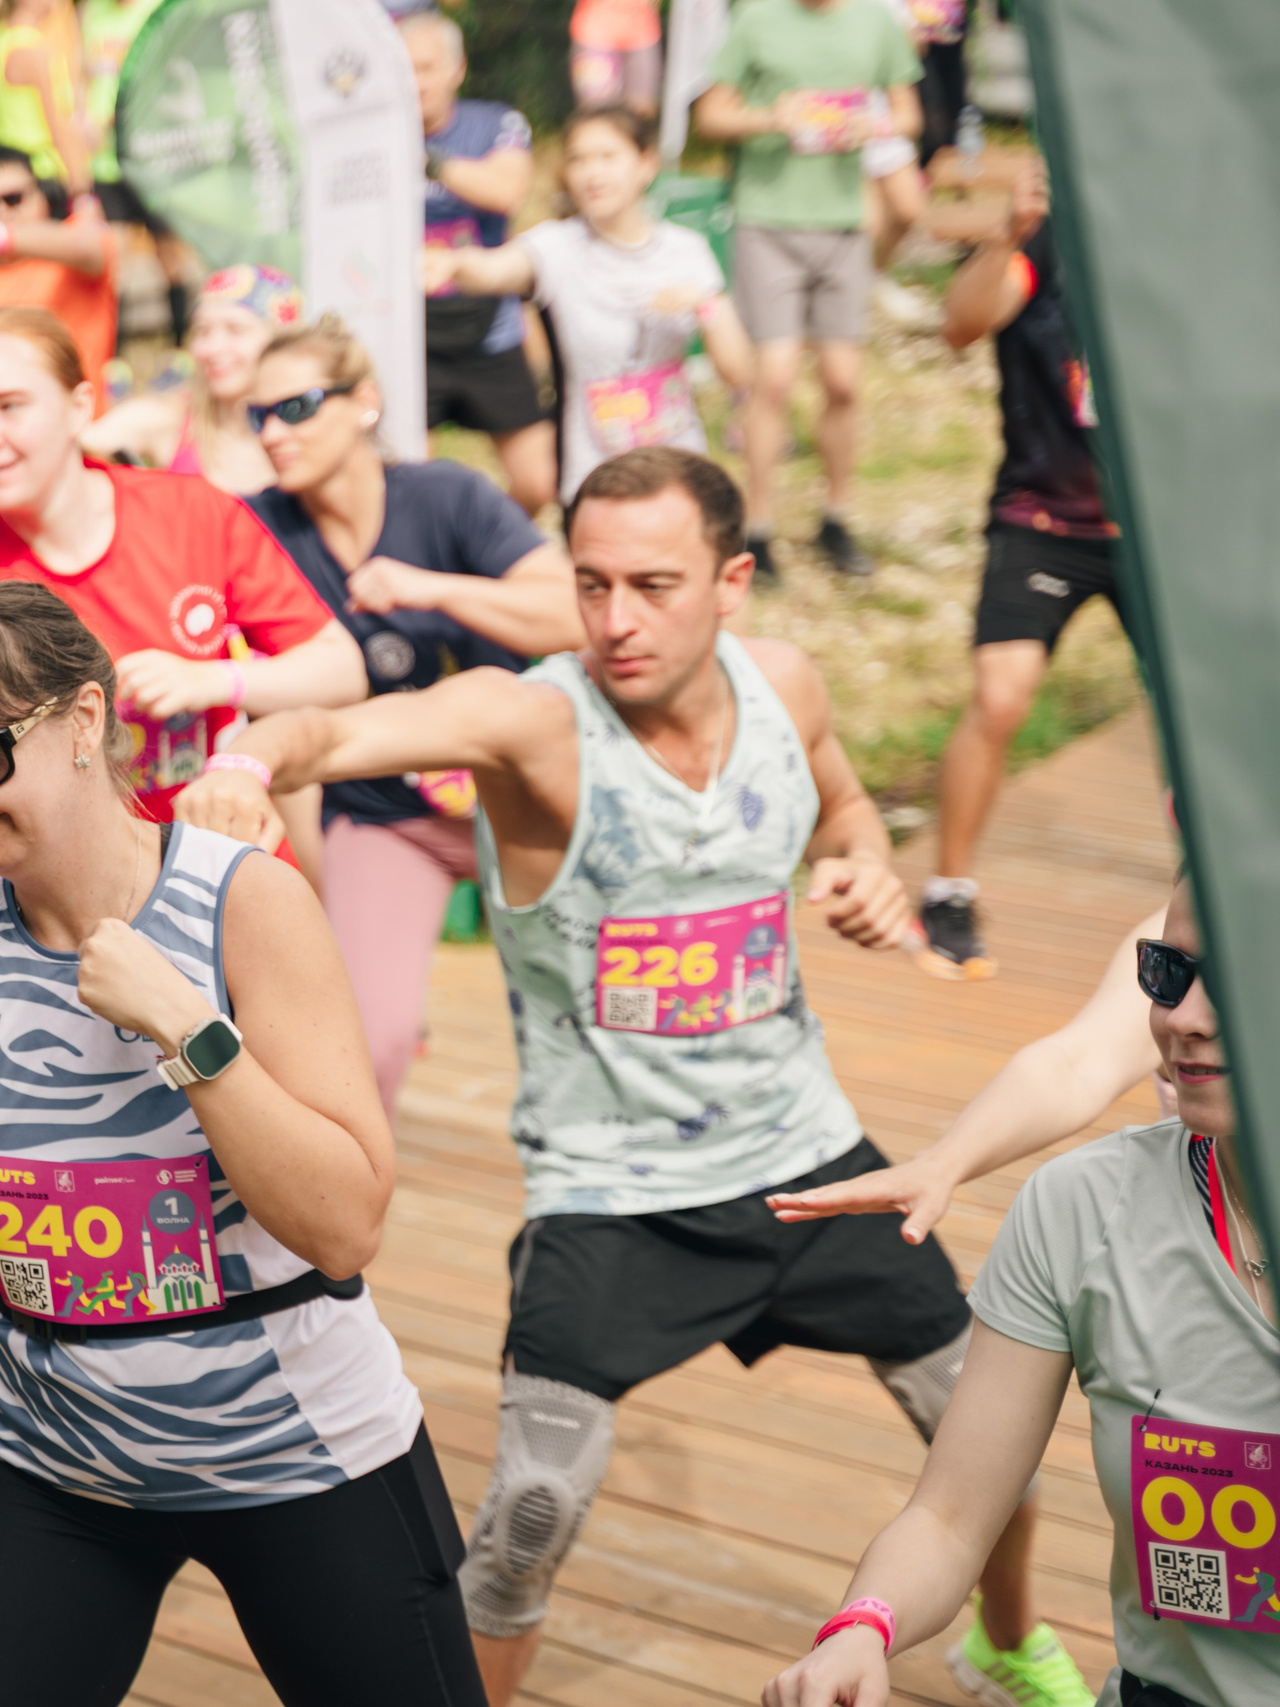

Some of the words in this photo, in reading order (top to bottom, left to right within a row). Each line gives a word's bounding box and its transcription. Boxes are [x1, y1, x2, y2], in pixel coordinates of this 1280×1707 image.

[600, 940, 719, 987] 226
[26, 1191, 49, 1200] 2023
[164, 1197, 179, 1216] 1
[156, 1217, 191, 1225] ВОЛНА
[1144, 1433, 1216, 1458] RUTS
[1145, 1459, 1199, 1475] КАЗАНЬ
[1201, 1467, 1234, 1478] 2023
